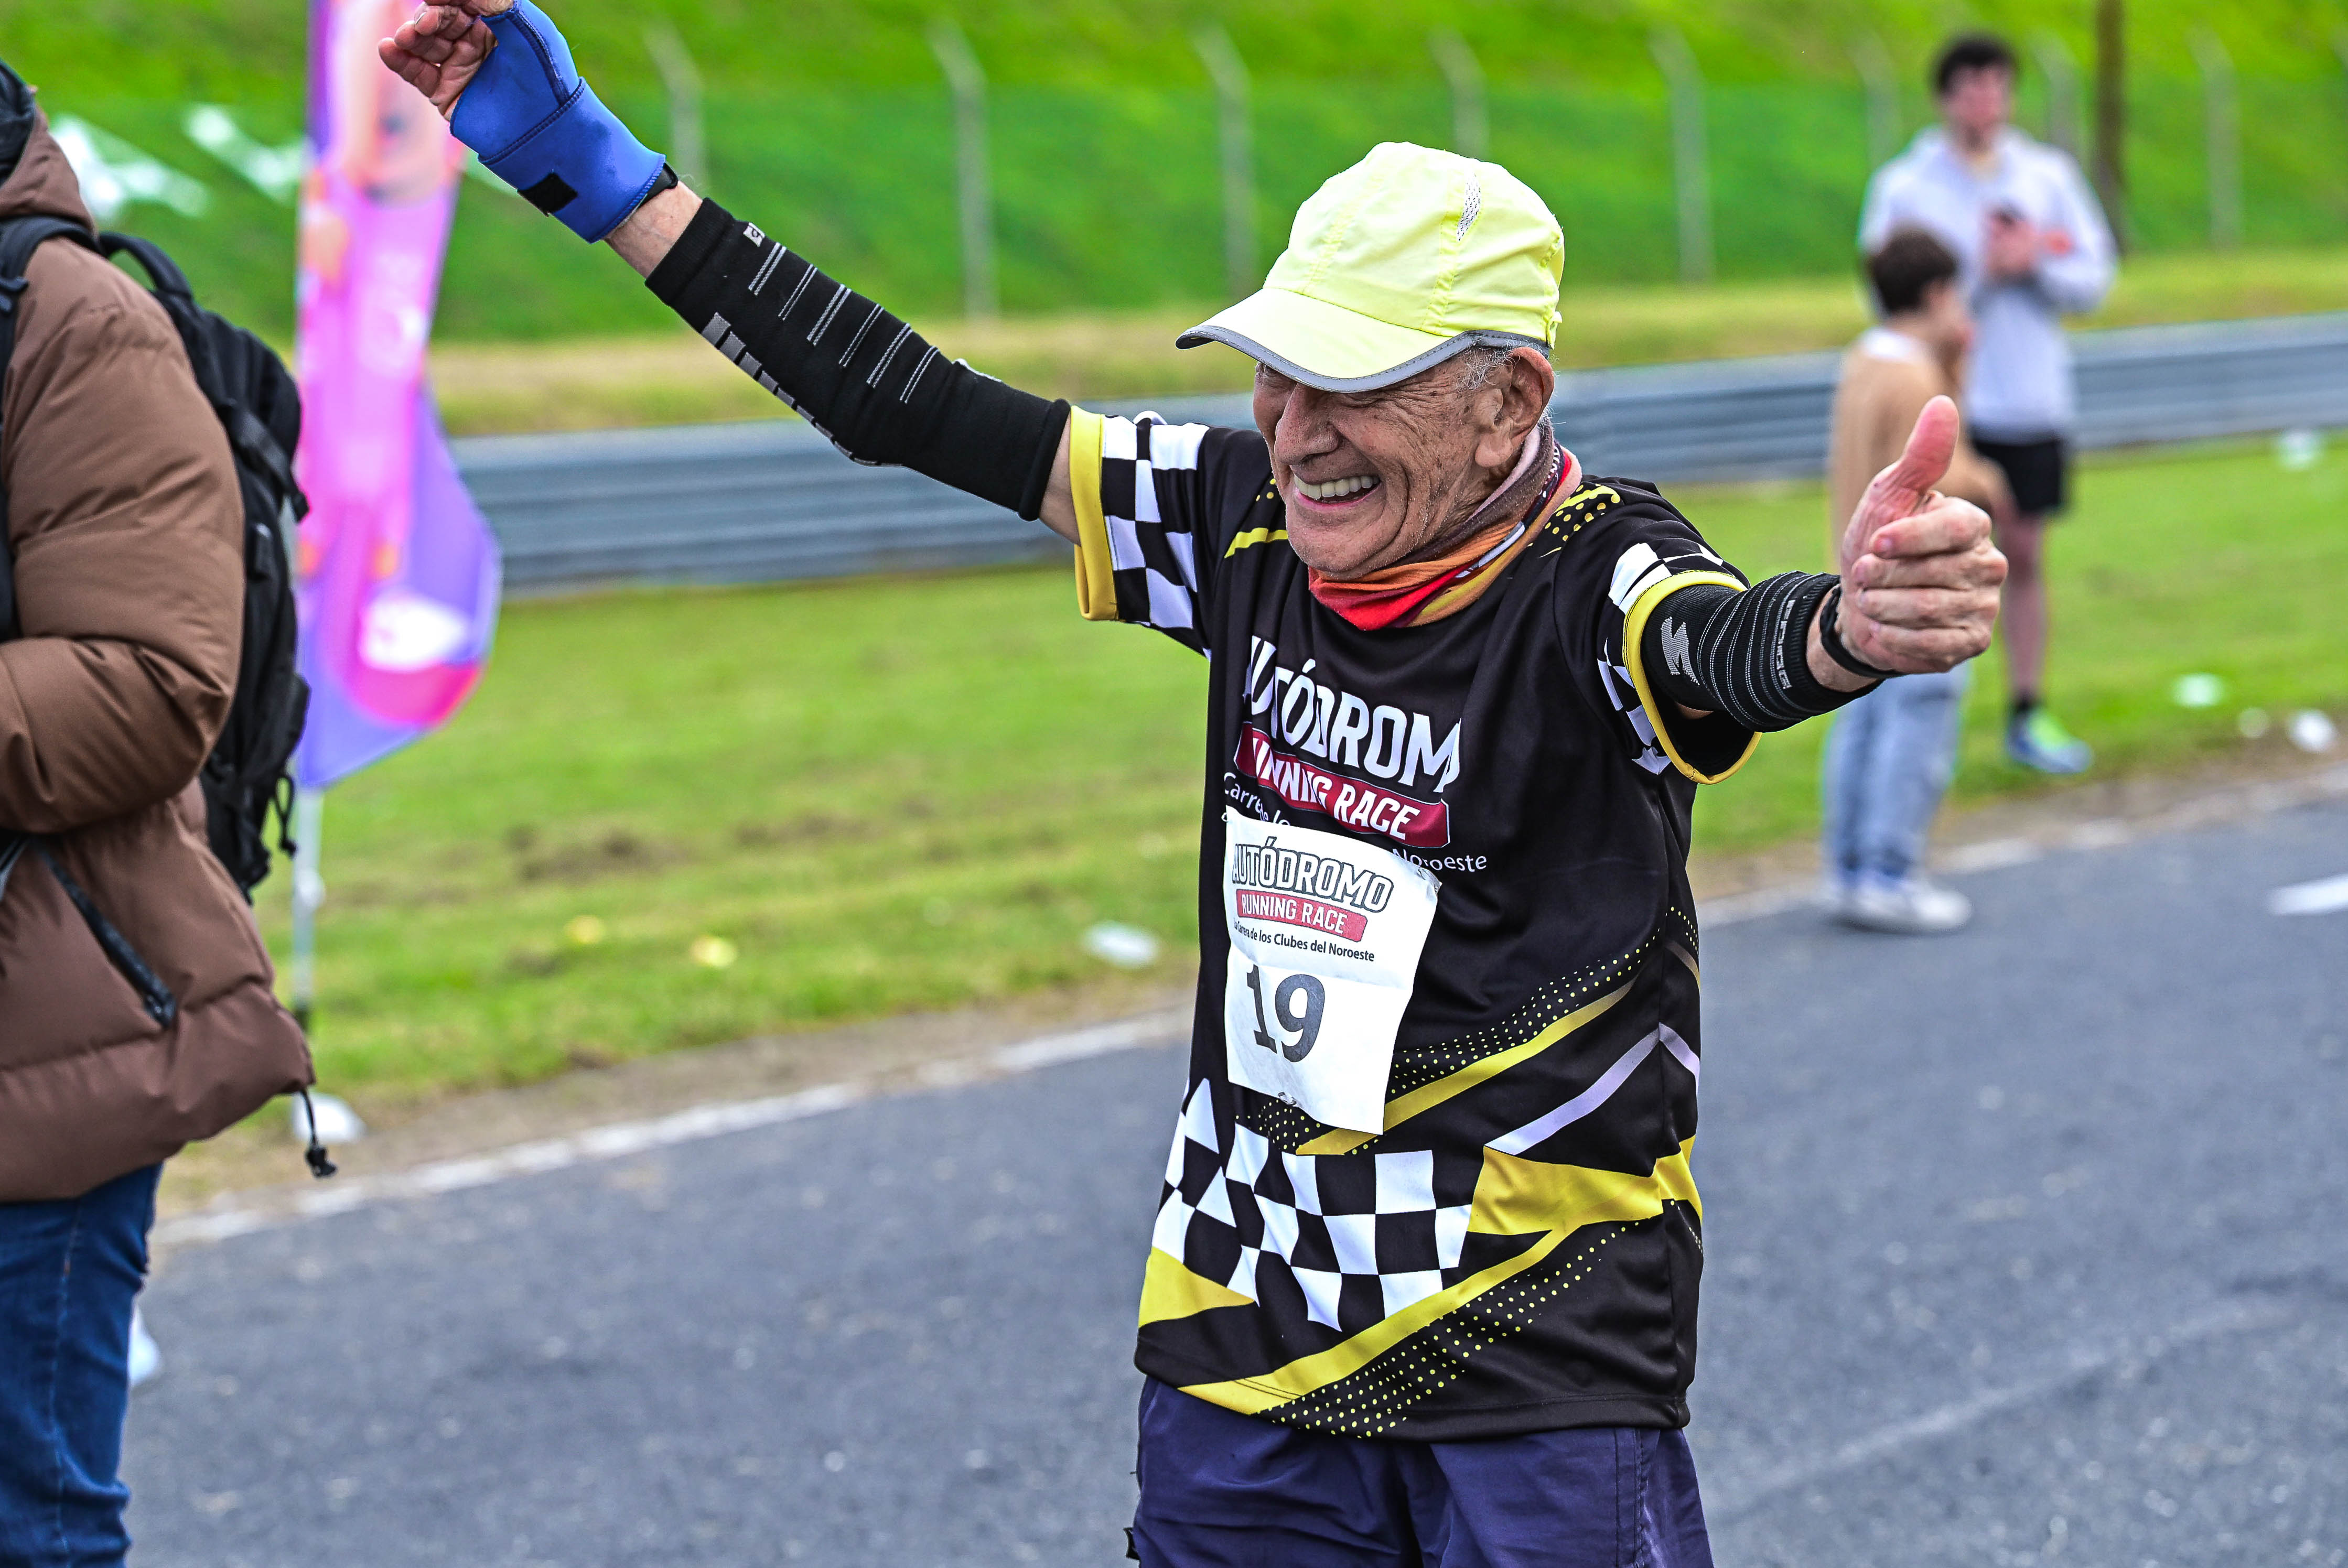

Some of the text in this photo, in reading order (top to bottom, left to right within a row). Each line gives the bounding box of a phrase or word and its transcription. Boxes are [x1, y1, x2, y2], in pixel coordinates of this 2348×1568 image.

[1333, 783, 1421, 840] RACE
[1232, 836, 1394, 913] AUTÓDROMO
[1241, 893, 1348, 934] RUNNING RACE
[1250, 927, 1258, 940] de
[1259, 929, 1272, 944] los
[1274, 933, 1308, 950] Clubes
[1310, 940, 1327, 953] del
[1328, 943, 1375, 961] Noroeste
[1246, 964, 1326, 1063] 19
